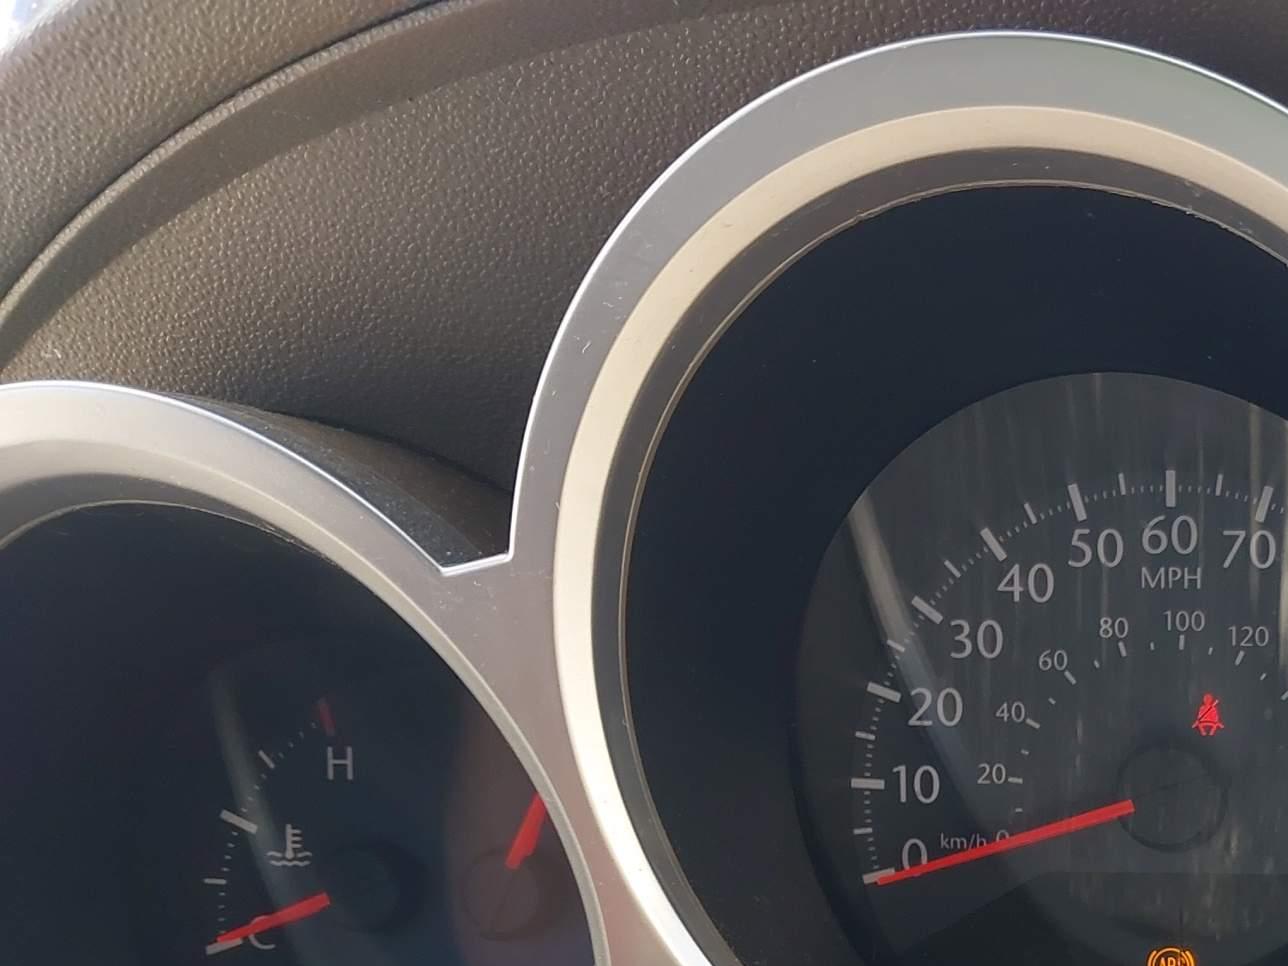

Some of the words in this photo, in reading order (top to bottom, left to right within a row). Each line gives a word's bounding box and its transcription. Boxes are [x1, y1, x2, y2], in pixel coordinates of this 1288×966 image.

[1068, 528, 1124, 568] 50
[1141, 515, 1198, 554] 60
[1222, 530, 1276, 569] 70
[996, 563, 1055, 603] 40
[1141, 567, 1201, 589] MPH
[1099, 618, 1129, 638] 80
[1163, 611, 1206, 632] 100
[1228, 626, 1270, 647] 120
[950, 619, 1004, 659] 30
[1038, 650, 1068, 671] 60
[908, 688, 963, 727] 20
[995, 702, 1026, 723] 40
[327, 746, 354, 780] H
[977, 764, 1006, 784] 20
[892, 765, 940, 803] 10
[902, 838, 929, 876] 0
[940, 832, 988, 851] km/h
